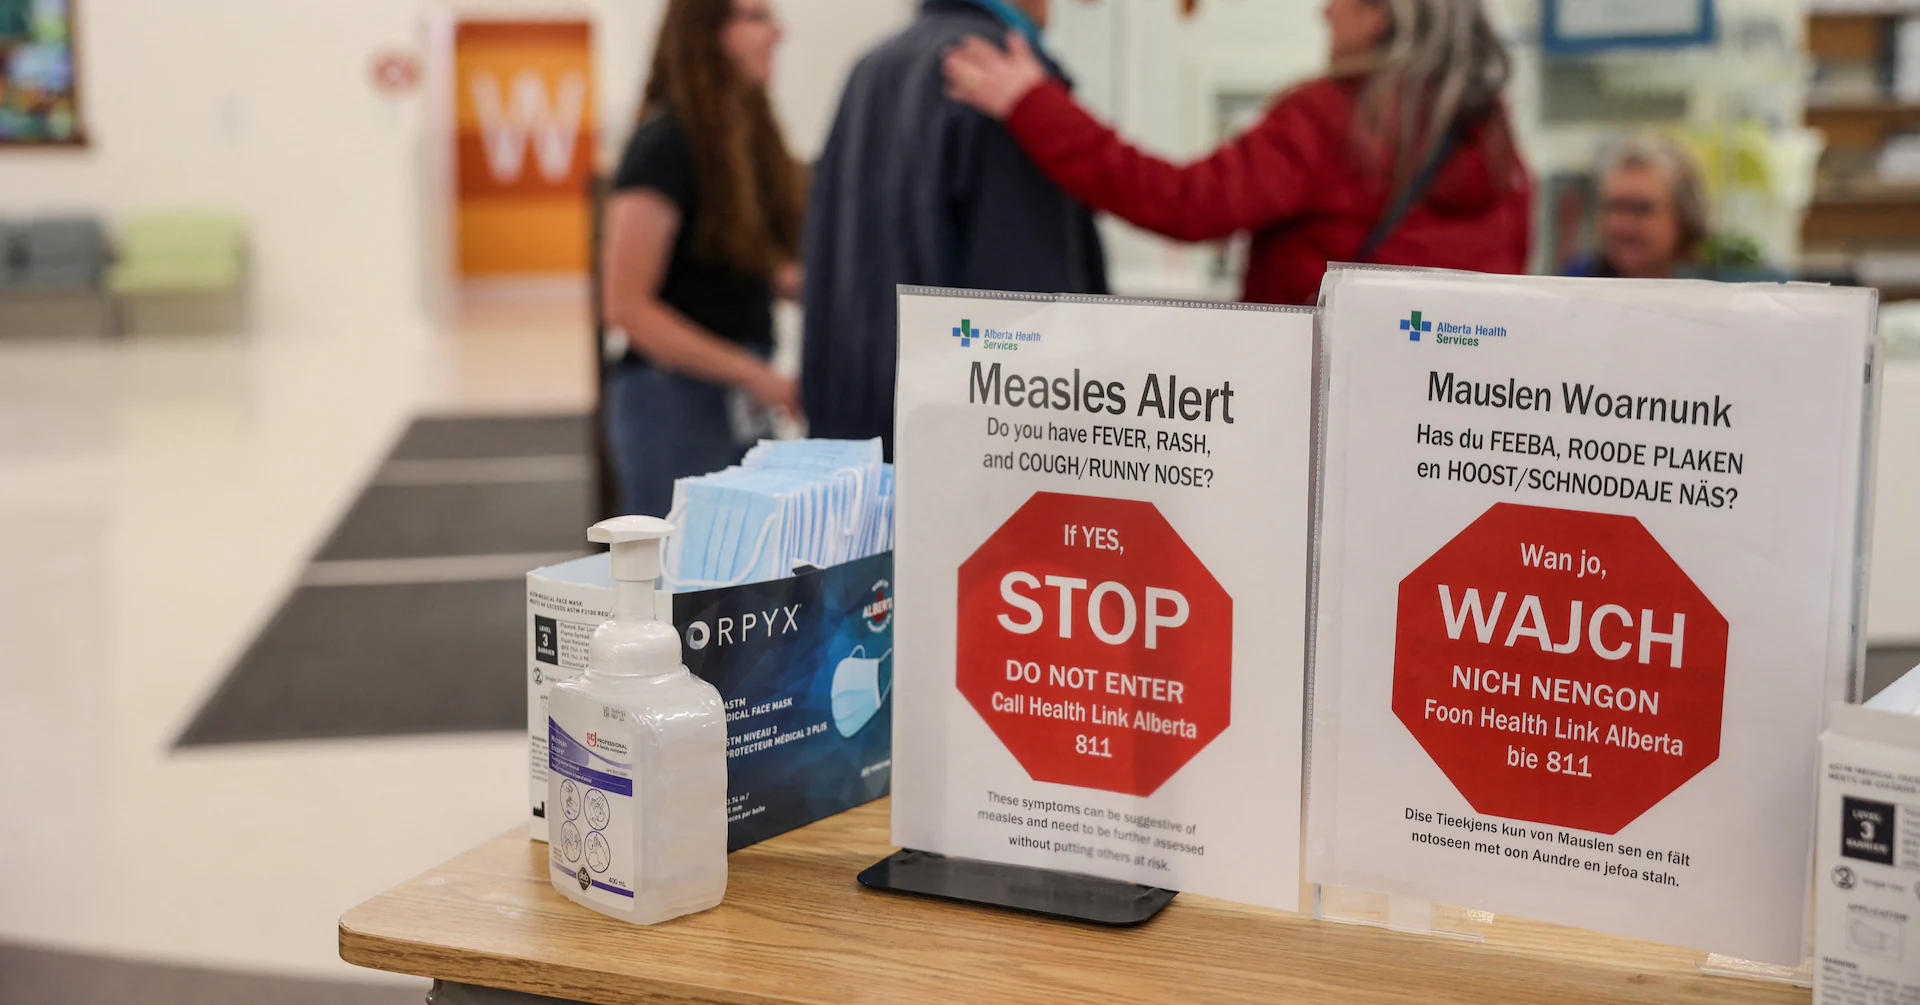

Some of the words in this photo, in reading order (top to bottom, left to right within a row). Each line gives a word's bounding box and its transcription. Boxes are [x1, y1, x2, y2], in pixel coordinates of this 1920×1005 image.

[984, 329, 1013, 341] Alberta
[1016, 331, 1041, 342] Health
[984, 340, 1018, 351] Services
[1436, 333, 1479, 347] Services
[1437, 322, 1472, 335] Alberta
[1475, 324, 1507, 338] Health
[969, 361, 1126, 415] Measles
[1137, 373, 1234, 424] Alert
[1428, 371, 1551, 412] Mauslen
[1562, 382, 1732, 428] Woarnunk
[987, 417, 1009, 437] Do
[1014, 423, 1043, 442] you
[1049, 423, 1087, 443] have
[1092, 425, 1151, 451] FEVER,
[1157, 431, 1211, 457] RASH,
[1417, 423, 1454, 447] Has
[1459, 428, 1483, 449] du
[1491, 430, 1561, 461] FEEBA,
[1568, 438, 1646, 466] ROODE
[1653, 446, 1743, 475] PLAKEN
[983, 452, 1013, 470] and
[1019, 452, 1150, 482] COUGH/RUNNY
[1155, 465, 1214, 488] NOSE?
[1417, 462, 1440, 479] en
[1448, 460, 1673, 503] HOOST/SCHNODDAJE
[1679, 479, 1738, 510] NÄS?
[1064, 524, 1077, 546] If
[1082, 526, 1124, 555] YES,
[1520, 542, 1572, 571] Wan
[1577, 550, 1607, 579] jo,
[539, 594, 555, 602] MEDICAL
[862, 597, 892, 619] ALBERT
[997, 570, 1190, 650] STOP
[542, 634, 548, 647] 3
[686, 604, 798, 650] ORPYX
[1437, 584, 1685, 668] WAJCH
[1006, 659, 1040, 684] DO
[1050, 664, 1098, 691] NOT
[1106, 671, 1184, 704] ENTER
[1452, 665, 1521, 697] NICH
[1531, 676, 1659, 715] NENGON
[725, 698, 746, 709] ASTM
[726, 711, 749, 722] DICAL
[752, 703, 770, 716] FACE
[772, 697, 792, 710] MASK
[992, 691, 1024, 714] Call
[1029, 696, 1085, 722] Health
[1092, 704, 1128, 728] Link
[1133, 710, 1197, 739] Alberta
[727, 735, 741, 747] STM
[744, 727, 771, 742] NIVEAU
[773, 725, 777, 734] 3
[774, 729, 805, 745] MÉDICAL
[806, 727, 811, 736] 3
[812, 722, 827, 734] PLIS
[1424, 698, 1473, 725] Foon
[1480, 706, 1547, 736] Health
[1555, 717, 1599, 743] Link
[1605, 724, 1683, 756] Alberta
[1075, 734, 1112, 758] 811
[1507, 745, 1538, 769] bie
[1546, 751, 1593, 778] 811
[988, 791, 1019, 806] These
[1022, 798, 1081, 815] symptoms
[1084, 807, 1104, 818] can
[1107, 810, 1121, 821] be
[1124, 814, 1182, 834] suggestive
[1185, 824, 1196, 835] of
[1860, 821, 1875, 840] 3
[978, 810, 1023, 825] measles
[1027, 816, 1048, 829] and
[1051, 820, 1079, 832] need
[1083, 825, 1094, 834] to
[1097, 826, 1110, 838] be
[1114, 829, 1151, 845] further
[1154, 838, 1204, 856] assessed
[1405, 807, 1432, 823] Dise
[1437, 812, 1498, 834] Tieekjens
[1502, 823, 1526, 838] kun
[1530, 829, 1553, 842] von
[1558, 831, 1614, 853] Mauslen
[1618, 843, 1642, 858] sen
[1646, 848, 1663, 860] en
[1667, 851, 1690, 867] fält
[1009, 835, 1050, 850] without
[1054, 842, 1094, 859] putting
[1097, 847, 1130, 864] others
[1134, 855, 1145, 866] at
[1148, 858, 1171, 872] risk.
[1412, 830, 1470, 850] notoseen
[1475, 841, 1500, 855] met
[1504, 847, 1528, 860] oon
[1532, 849, 1580, 868] Aundre
[1584, 859, 1600, 872] en
[1604, 863, 1638, 879] jefoa
[1642, 870, 1679, 887] staln.
